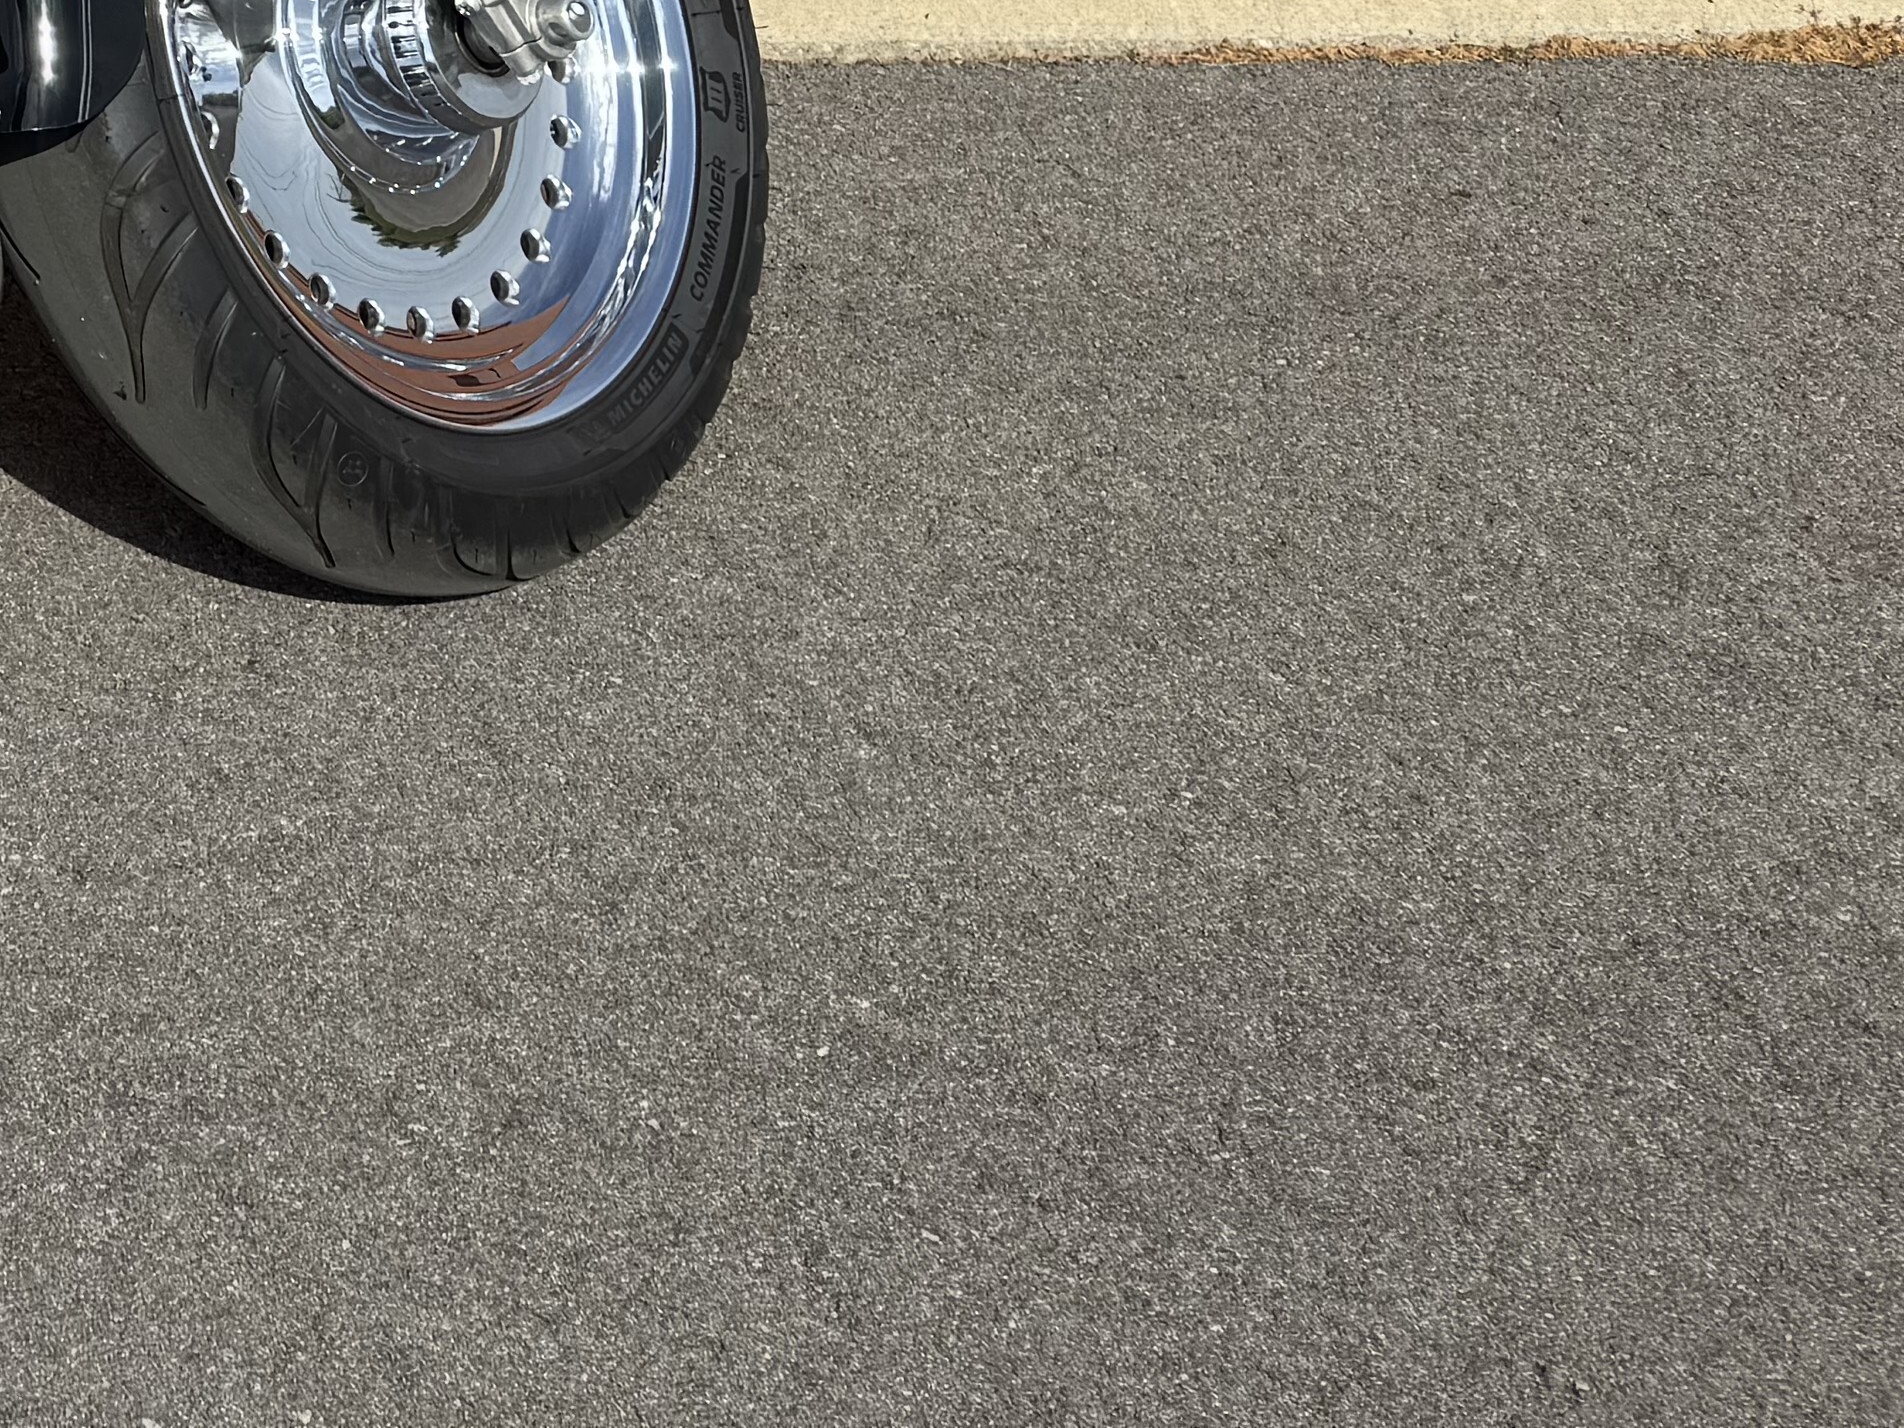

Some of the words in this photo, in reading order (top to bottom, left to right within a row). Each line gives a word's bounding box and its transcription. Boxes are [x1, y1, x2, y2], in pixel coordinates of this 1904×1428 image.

[732, 71, 746, 133] CRUISER
[690, 155, 727, 303] COMMANDER
[608, 330, 683, 426] MICHELIN
